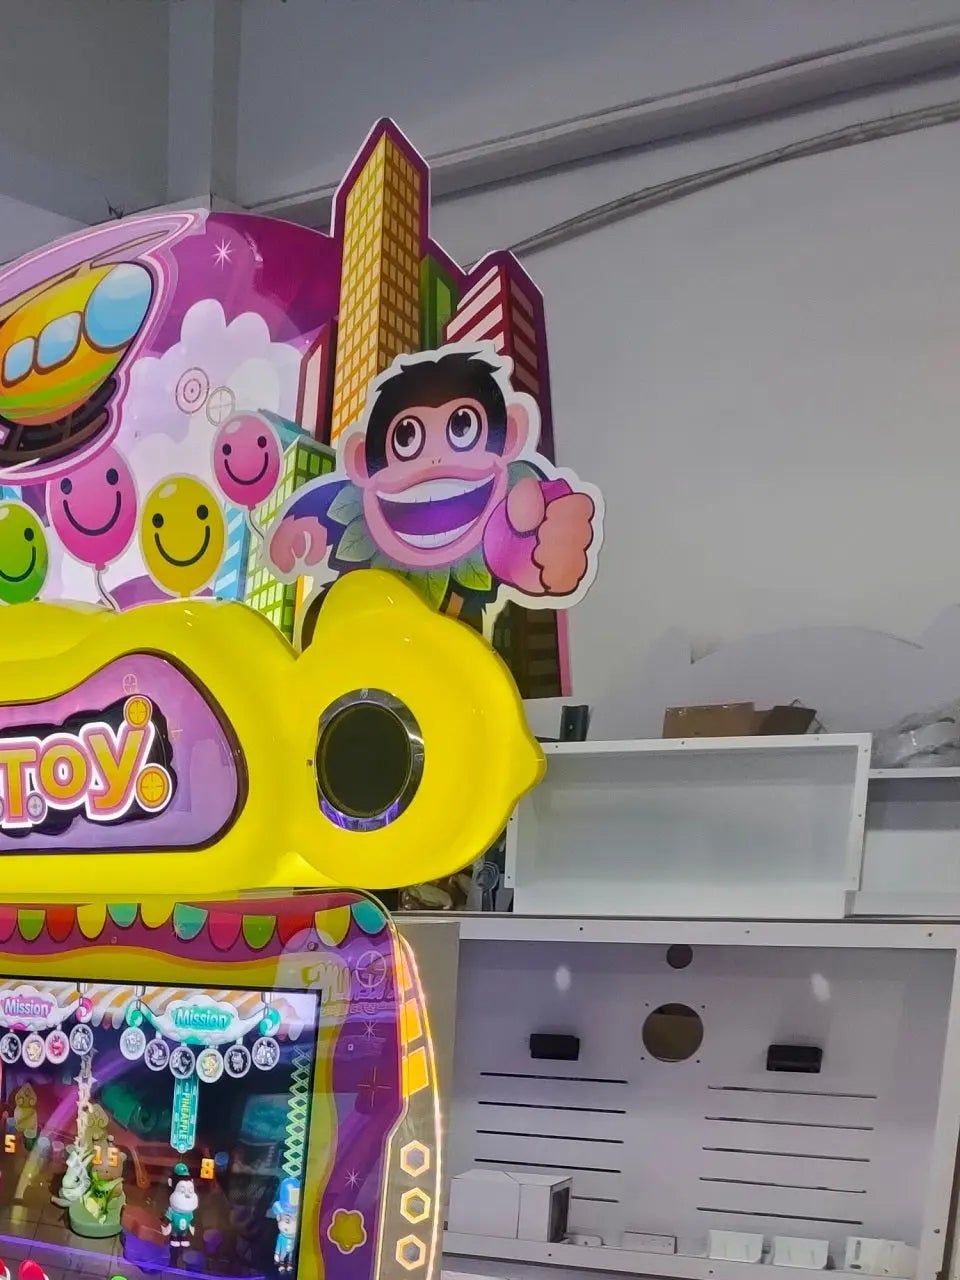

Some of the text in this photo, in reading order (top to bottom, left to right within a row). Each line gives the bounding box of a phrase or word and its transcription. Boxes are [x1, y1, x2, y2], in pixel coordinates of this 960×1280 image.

[3, 997, 49, 1016] Mission
[174, 1007, 229, 1028] Mission
[180, 1091, 193, 1142] PINEAPPLE
[4, 1135, 16, 1153] 5
[93, 1145, 119, 1166] 15
[200, 1157, 215, 1180] 8
